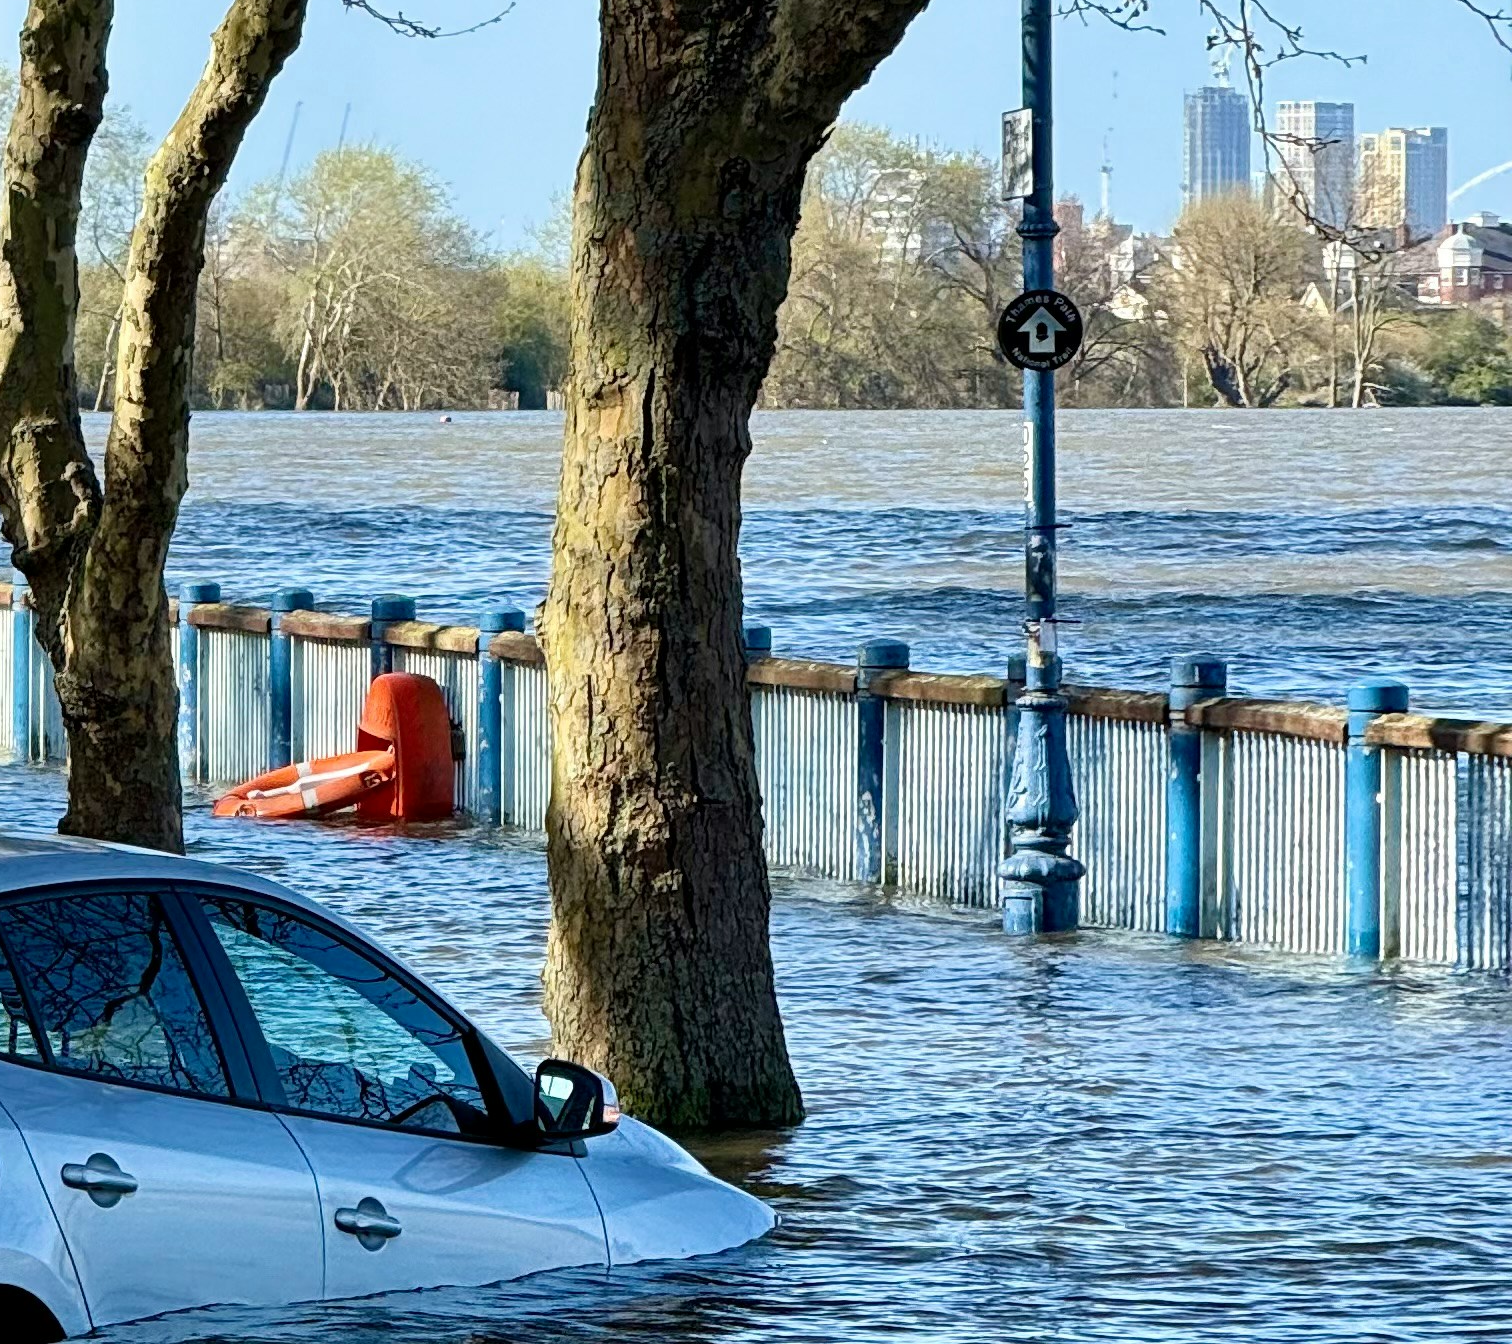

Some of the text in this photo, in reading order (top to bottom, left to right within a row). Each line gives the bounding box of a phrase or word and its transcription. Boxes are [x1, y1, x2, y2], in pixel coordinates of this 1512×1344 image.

[1005, 295, 1076, 323] Thames Path
[1011, 347, 1073, 368] National Trail
